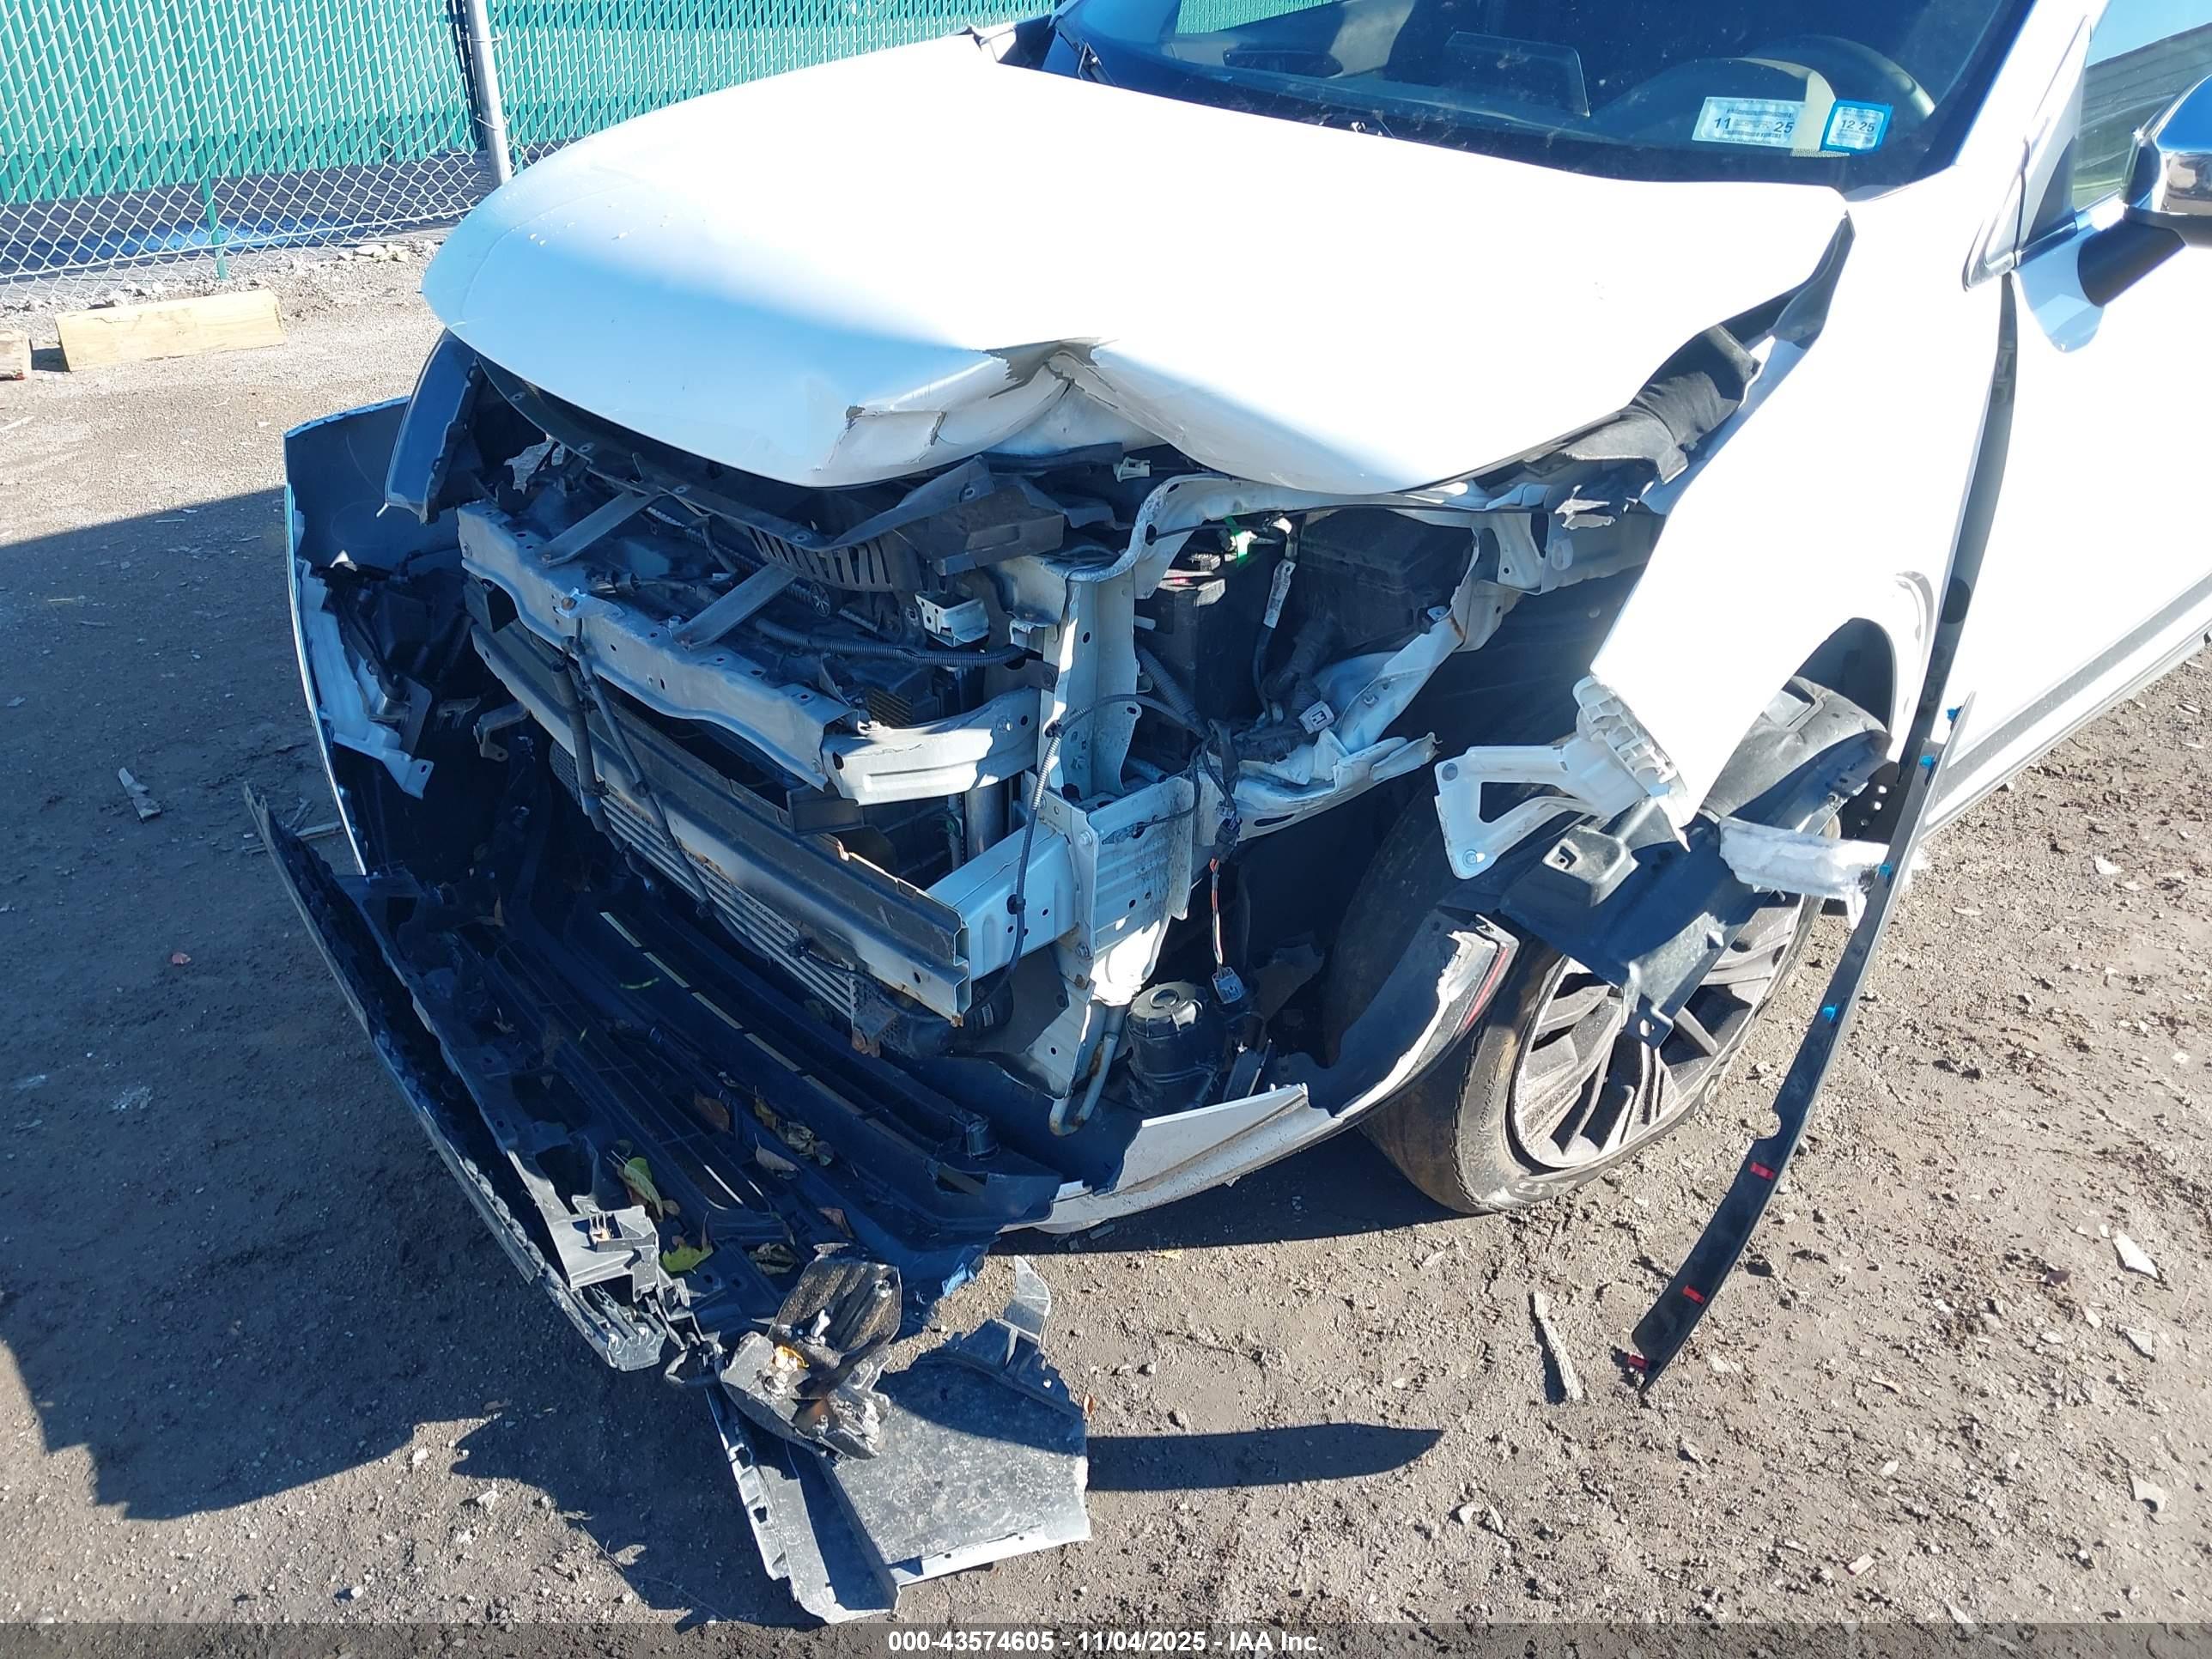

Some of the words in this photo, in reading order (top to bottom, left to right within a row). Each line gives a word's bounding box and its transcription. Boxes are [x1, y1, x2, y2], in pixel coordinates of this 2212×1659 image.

[1714, 117, 1732, 130] 11
[1773, 120, 1795, 134] 25
[1841, 119, 1856, 130] 12
[1858, 120, 1876, 132] 25
